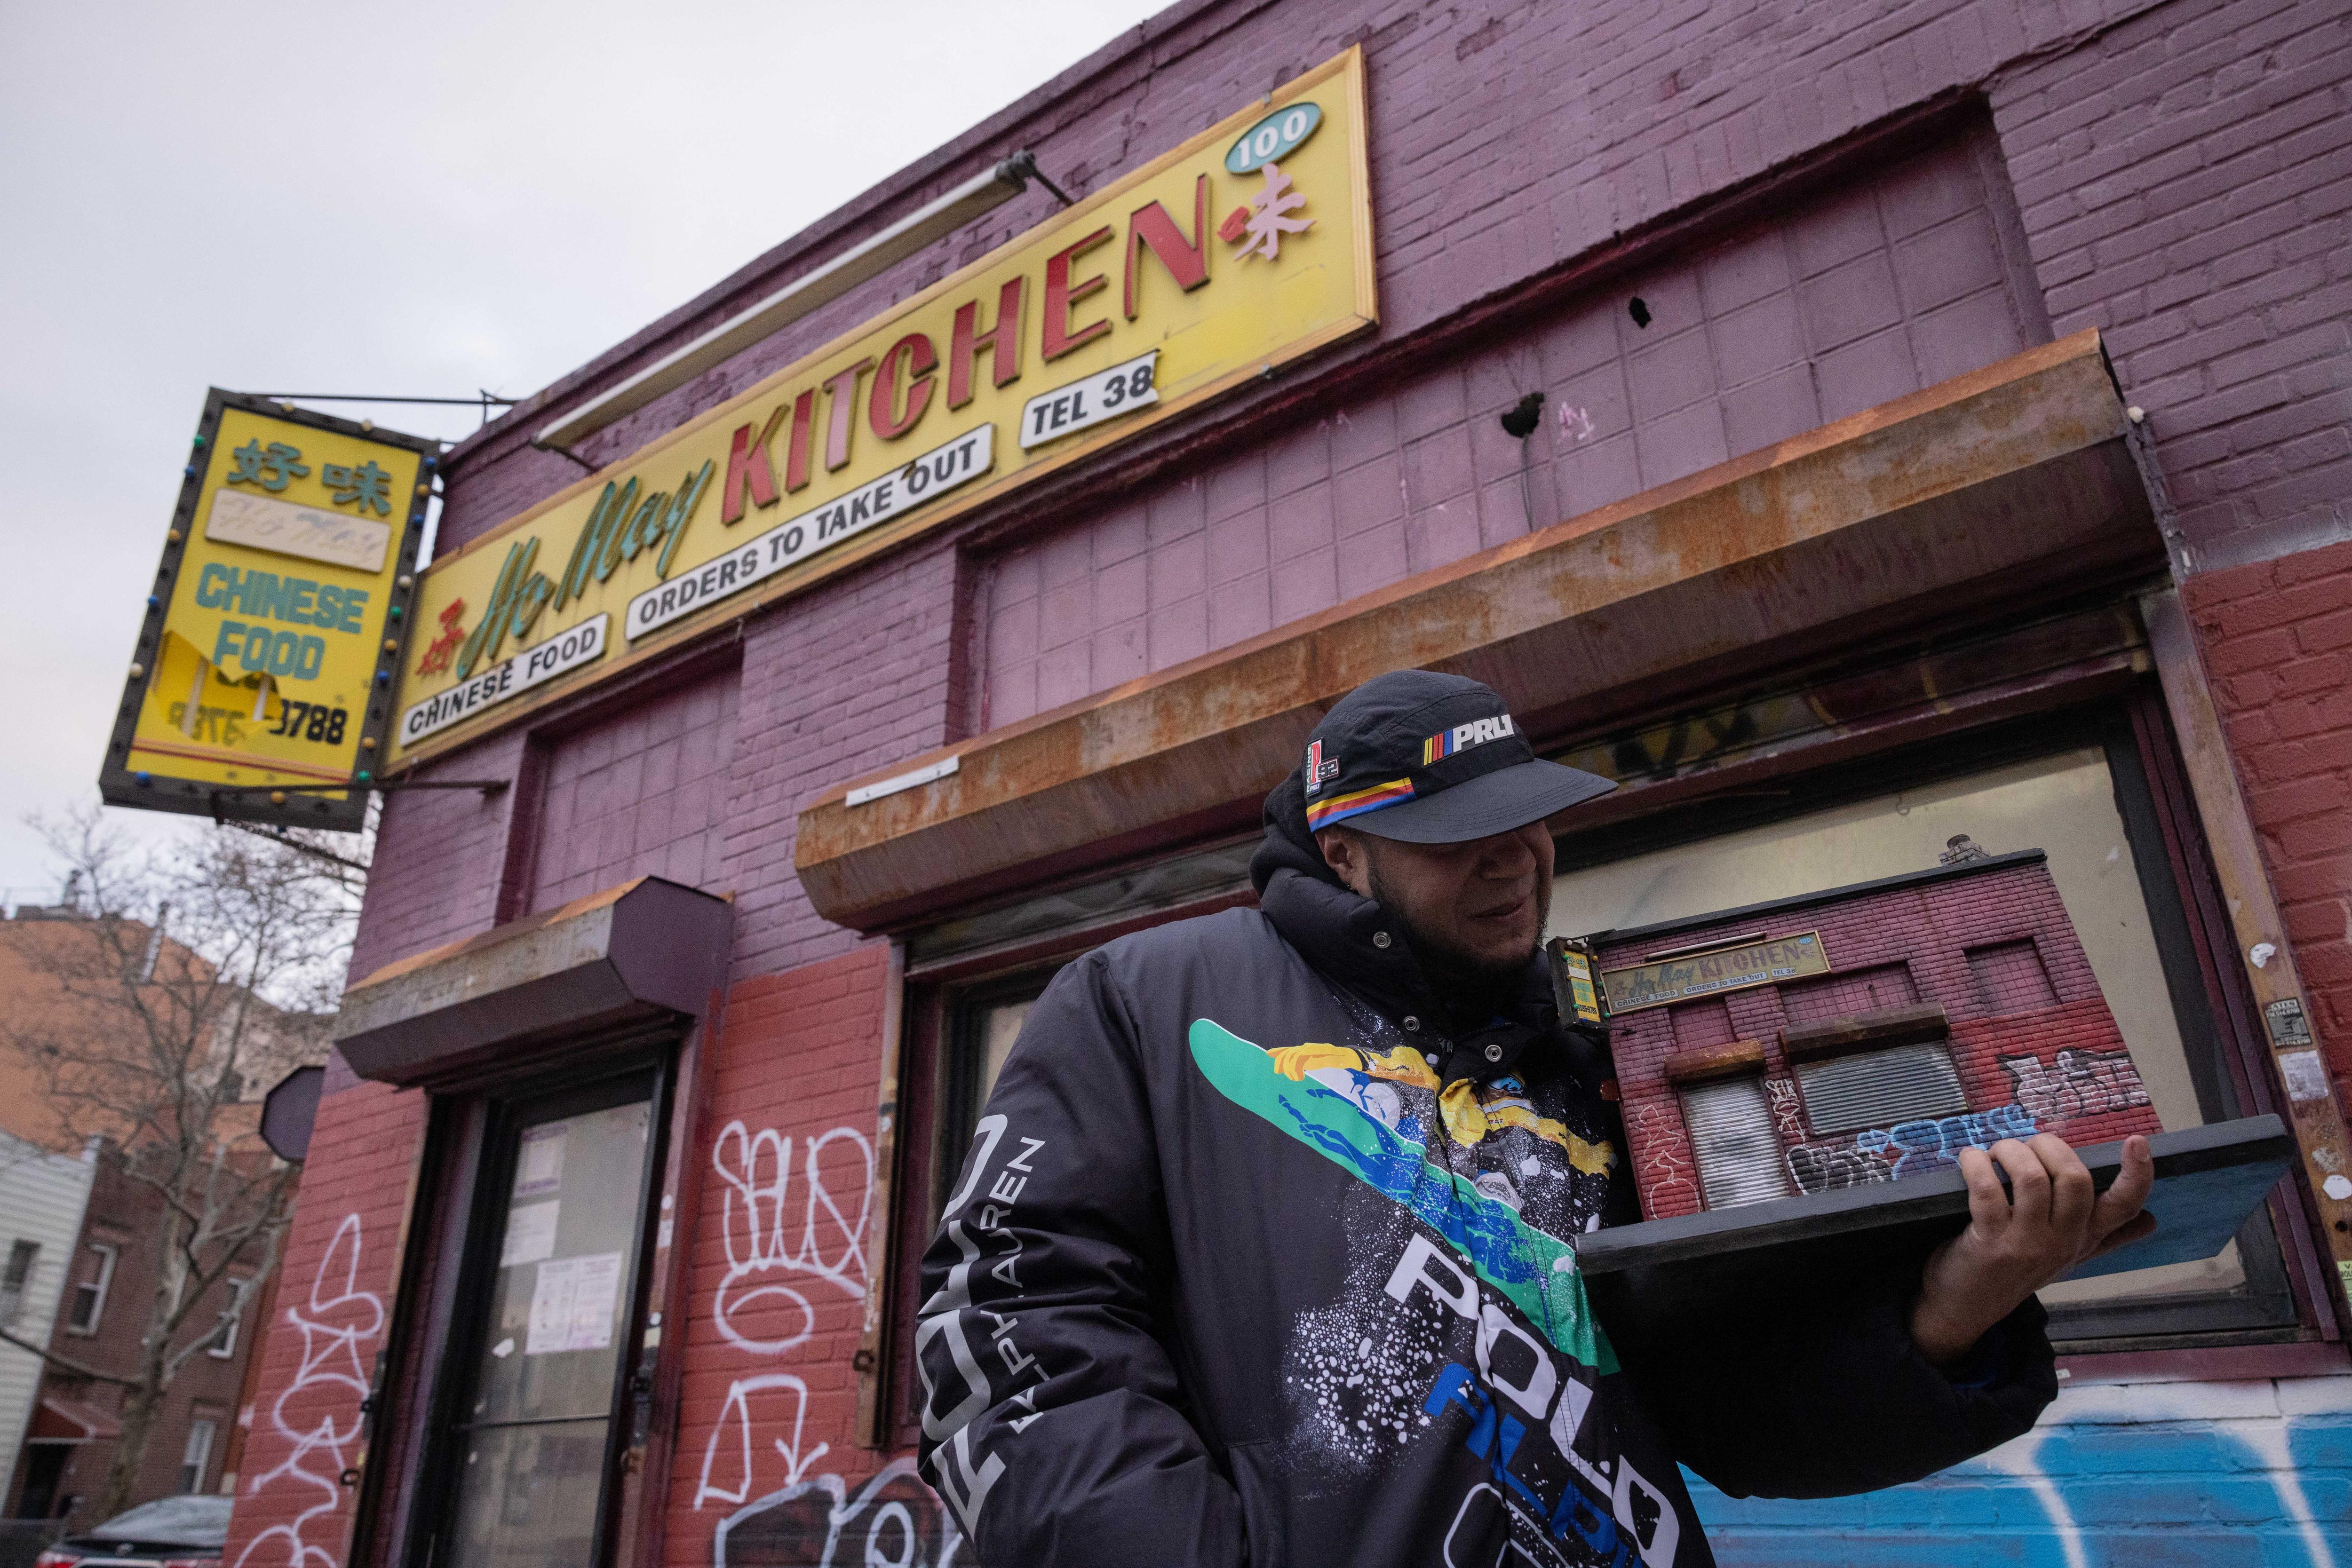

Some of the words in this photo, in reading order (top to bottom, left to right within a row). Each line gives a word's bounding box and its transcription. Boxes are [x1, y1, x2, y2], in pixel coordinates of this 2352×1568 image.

[1237, 110, 1307, 168] 100
[1217, 163, 1317, 261] 味
[456, 536, 556, 680] Ho
[554, 458, 717, 611] May
[722, 172, 1212, 526] KITCHEN
[1032, 391, 1088, 436] TEL
[1102, 364, 1153, 409] 38
[227, 437, 391, 515] 好味
[639, 548, 758, 625] ORDERS
[769, 526, 804, 564] TO
[815, 479, 896, 541] TAKE
[907, 438, 977, 495] OUT
[195, 562, 369, 634] CHINESE
[213, 620, 326, 681] FOOD
[407, 668, 516, 735] CHINESE
[527, 627, 597, 679] FOOD
[1318, 760, 1337, 779] 92
[1686, 982, 1717, 993] ORDERS
[1729, 976, 1747, 984] TAKE
[1698, 942, 1801, 979] KITCHEN
[1617, 994, 1651, 1007] CHINESE
[1655, 990, 1676, 999] FOOD
[980, 1136, 1046, 1298] AUREN
[1384, 1232, 1680, 1568] POLO
